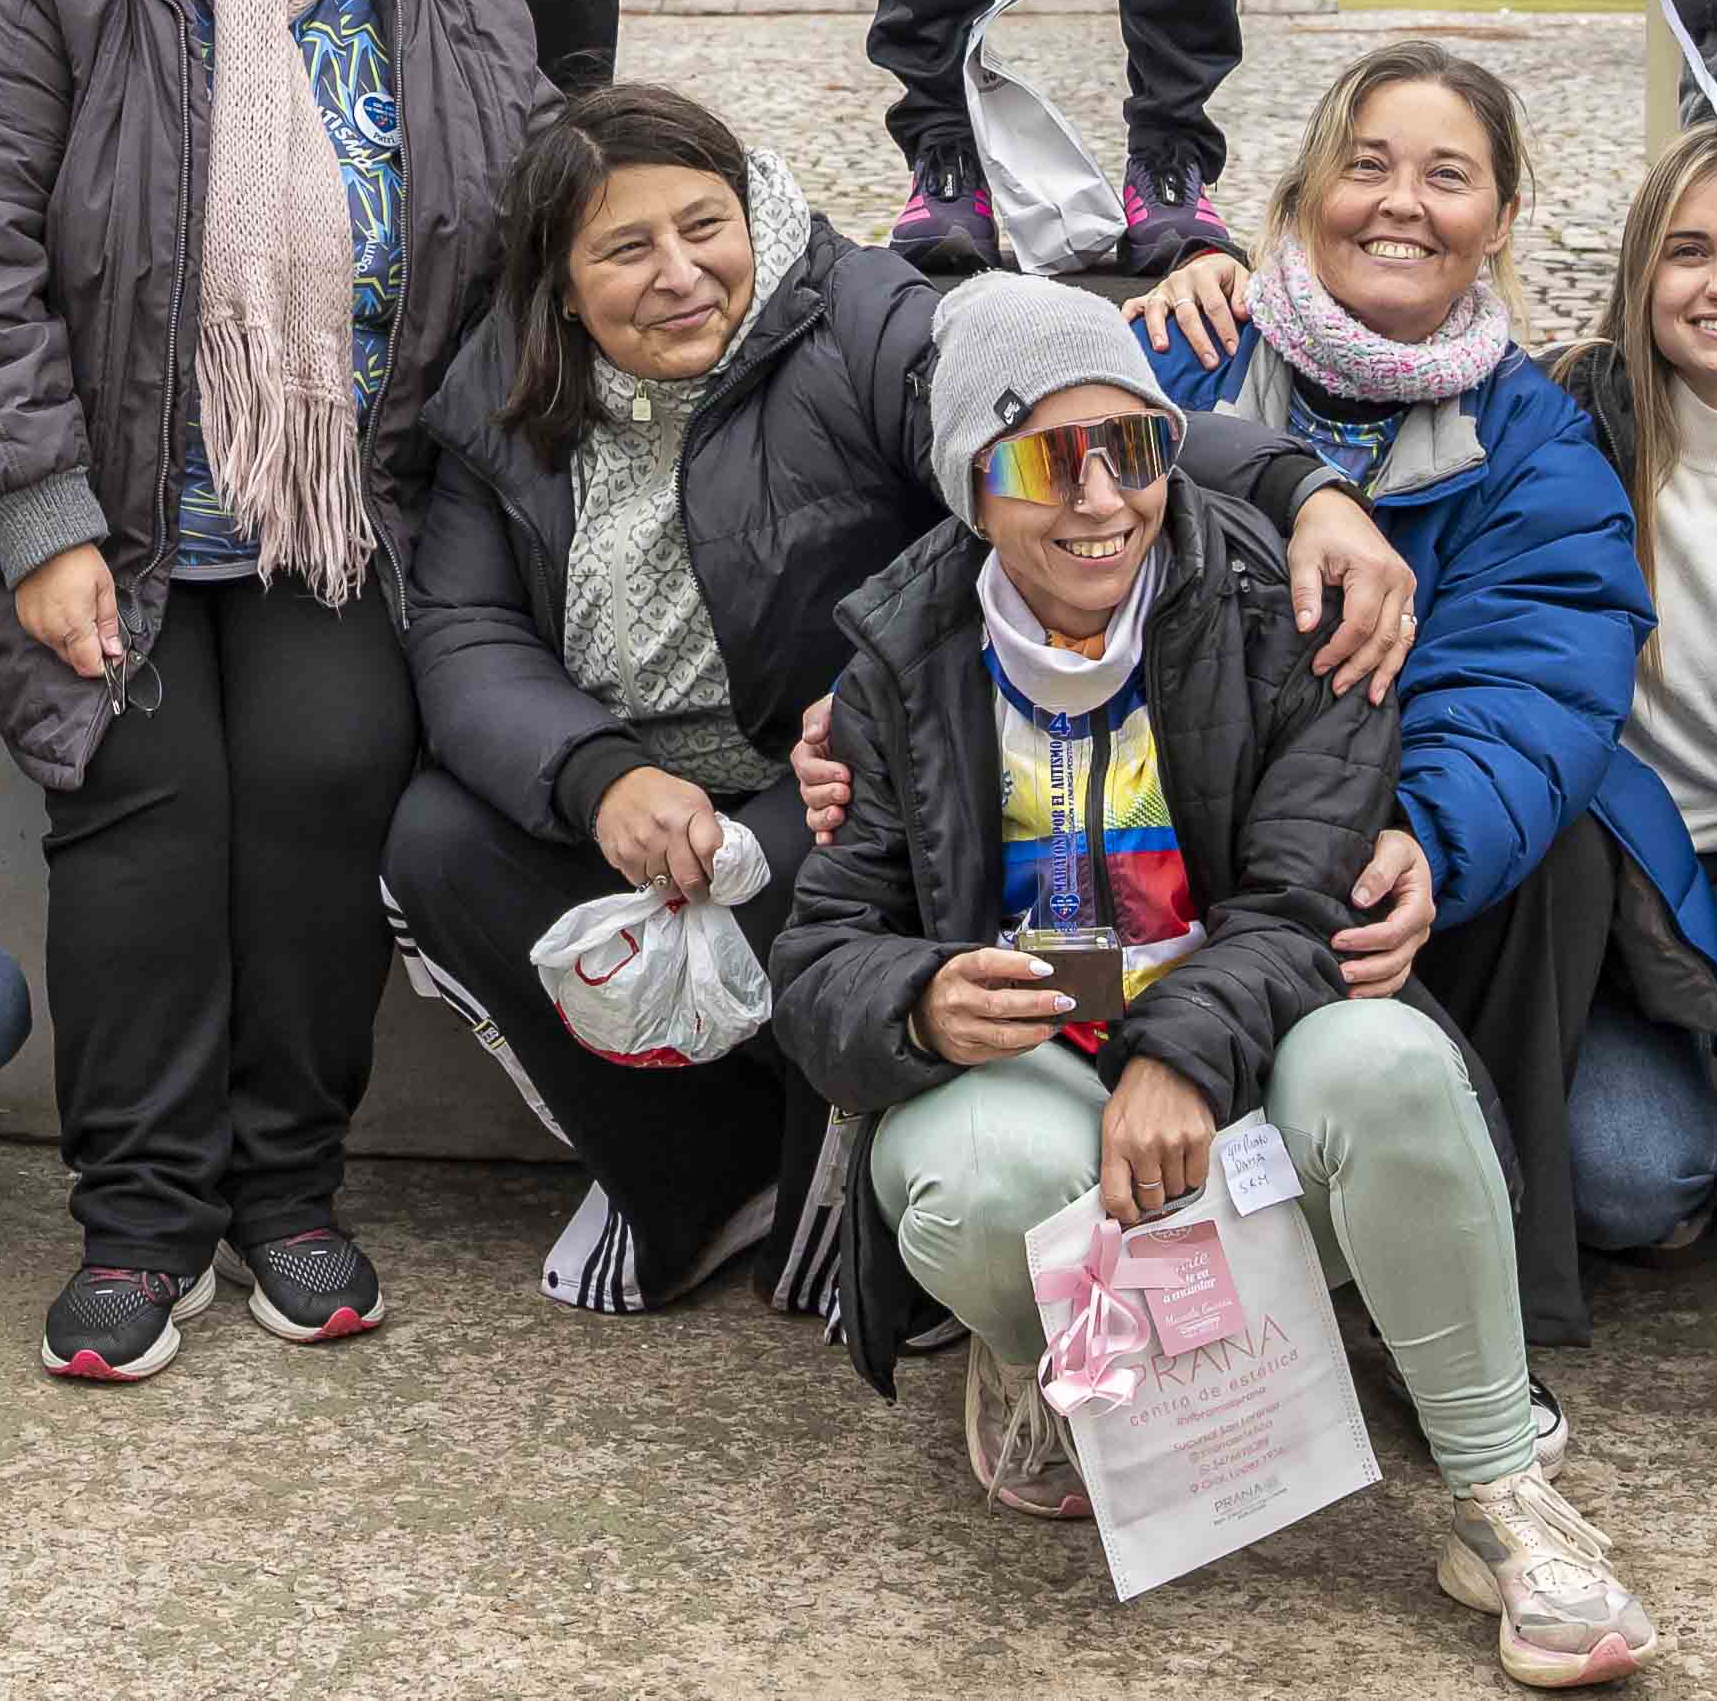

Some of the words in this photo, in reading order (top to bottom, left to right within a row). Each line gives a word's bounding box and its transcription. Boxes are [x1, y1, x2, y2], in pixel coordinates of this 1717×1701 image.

[1049, 711, 1071, 736] 4
[1049, 740, 1064, 789] AUTISMO
[1051, 794, 1065, 806] EL
[1051, 809, 1065, 834] POR
[1198, 1385, 1222, 1403] de
